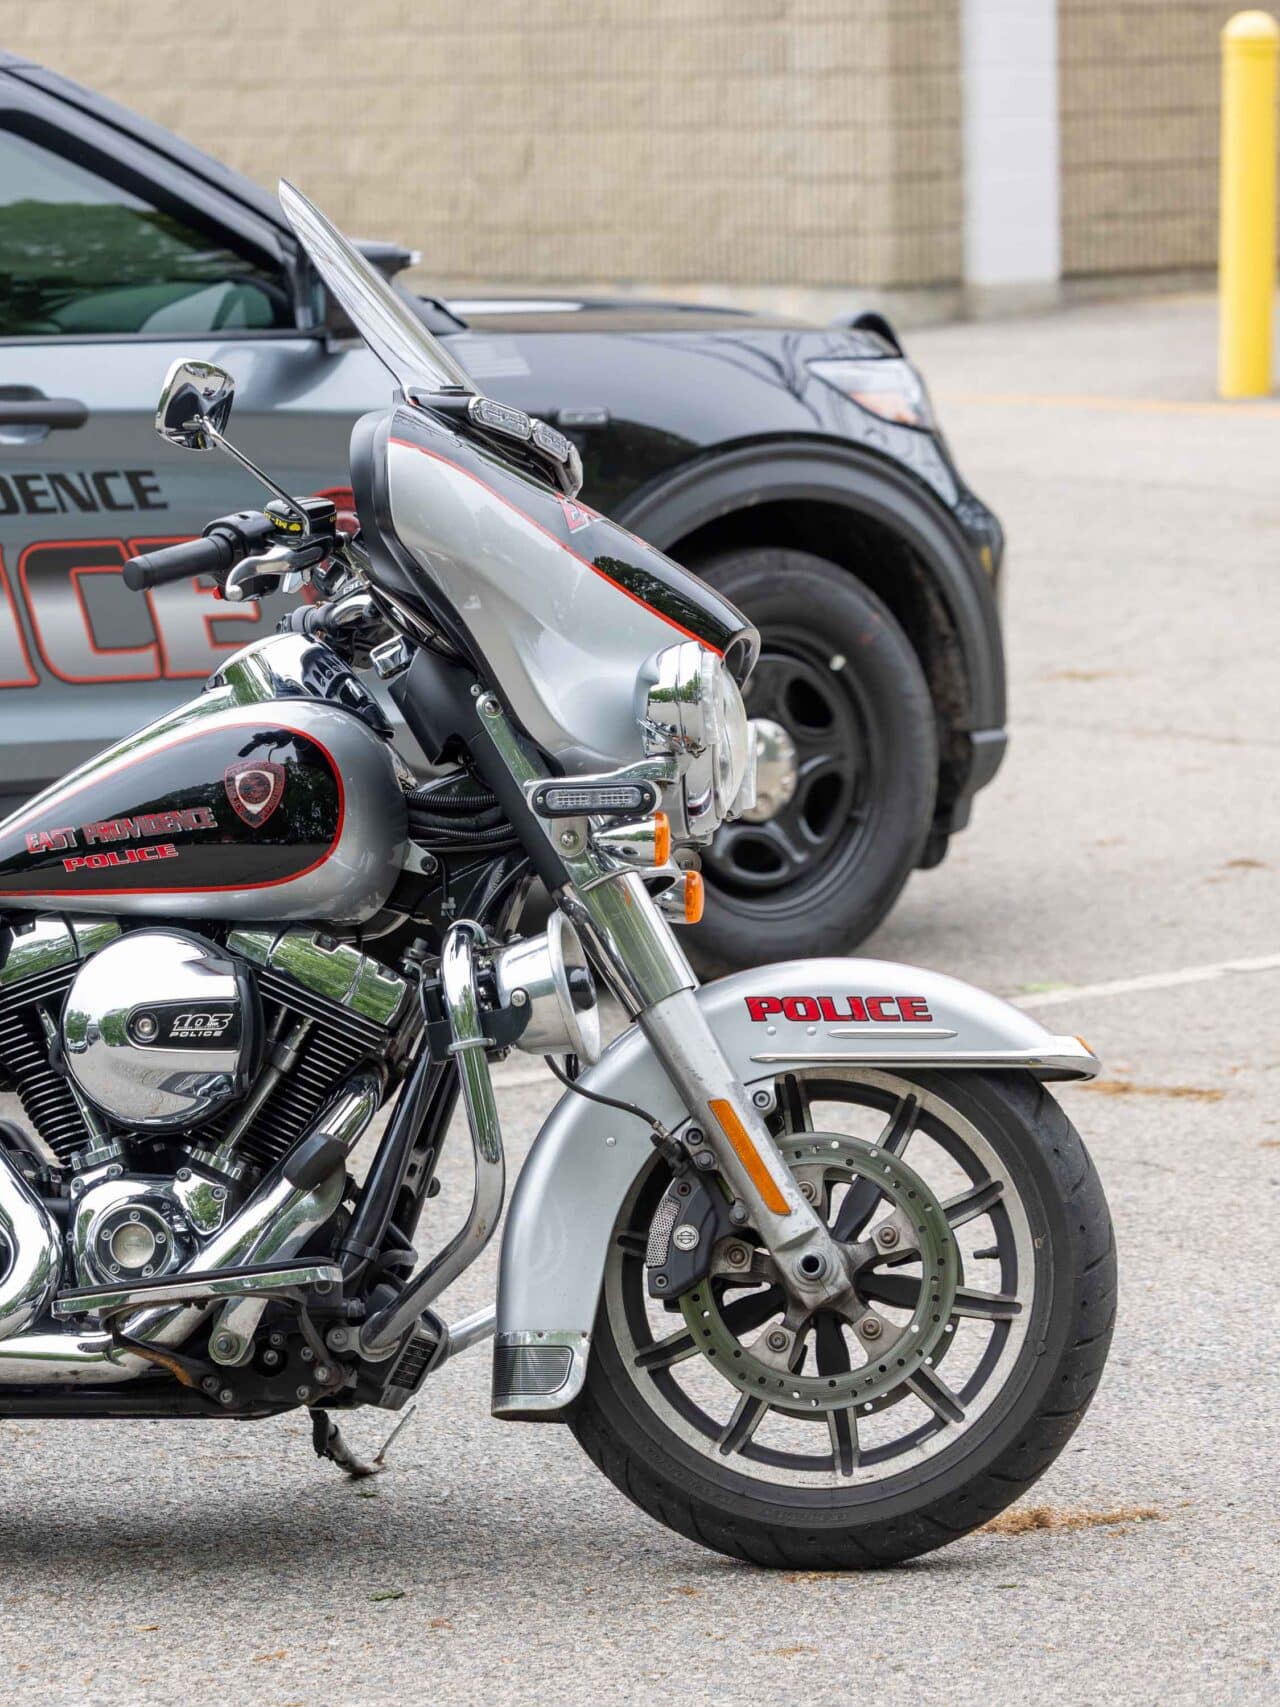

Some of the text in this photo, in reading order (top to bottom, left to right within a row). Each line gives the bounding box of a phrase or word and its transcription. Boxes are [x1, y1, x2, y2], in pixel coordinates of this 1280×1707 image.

[25, 808, 218, 854] EAST PROVIDENCE
[63, 845, 178, 872] POLICE
[173, 1013, 233, 1031] 103
[744, 996, 933, 1022] POLICE
